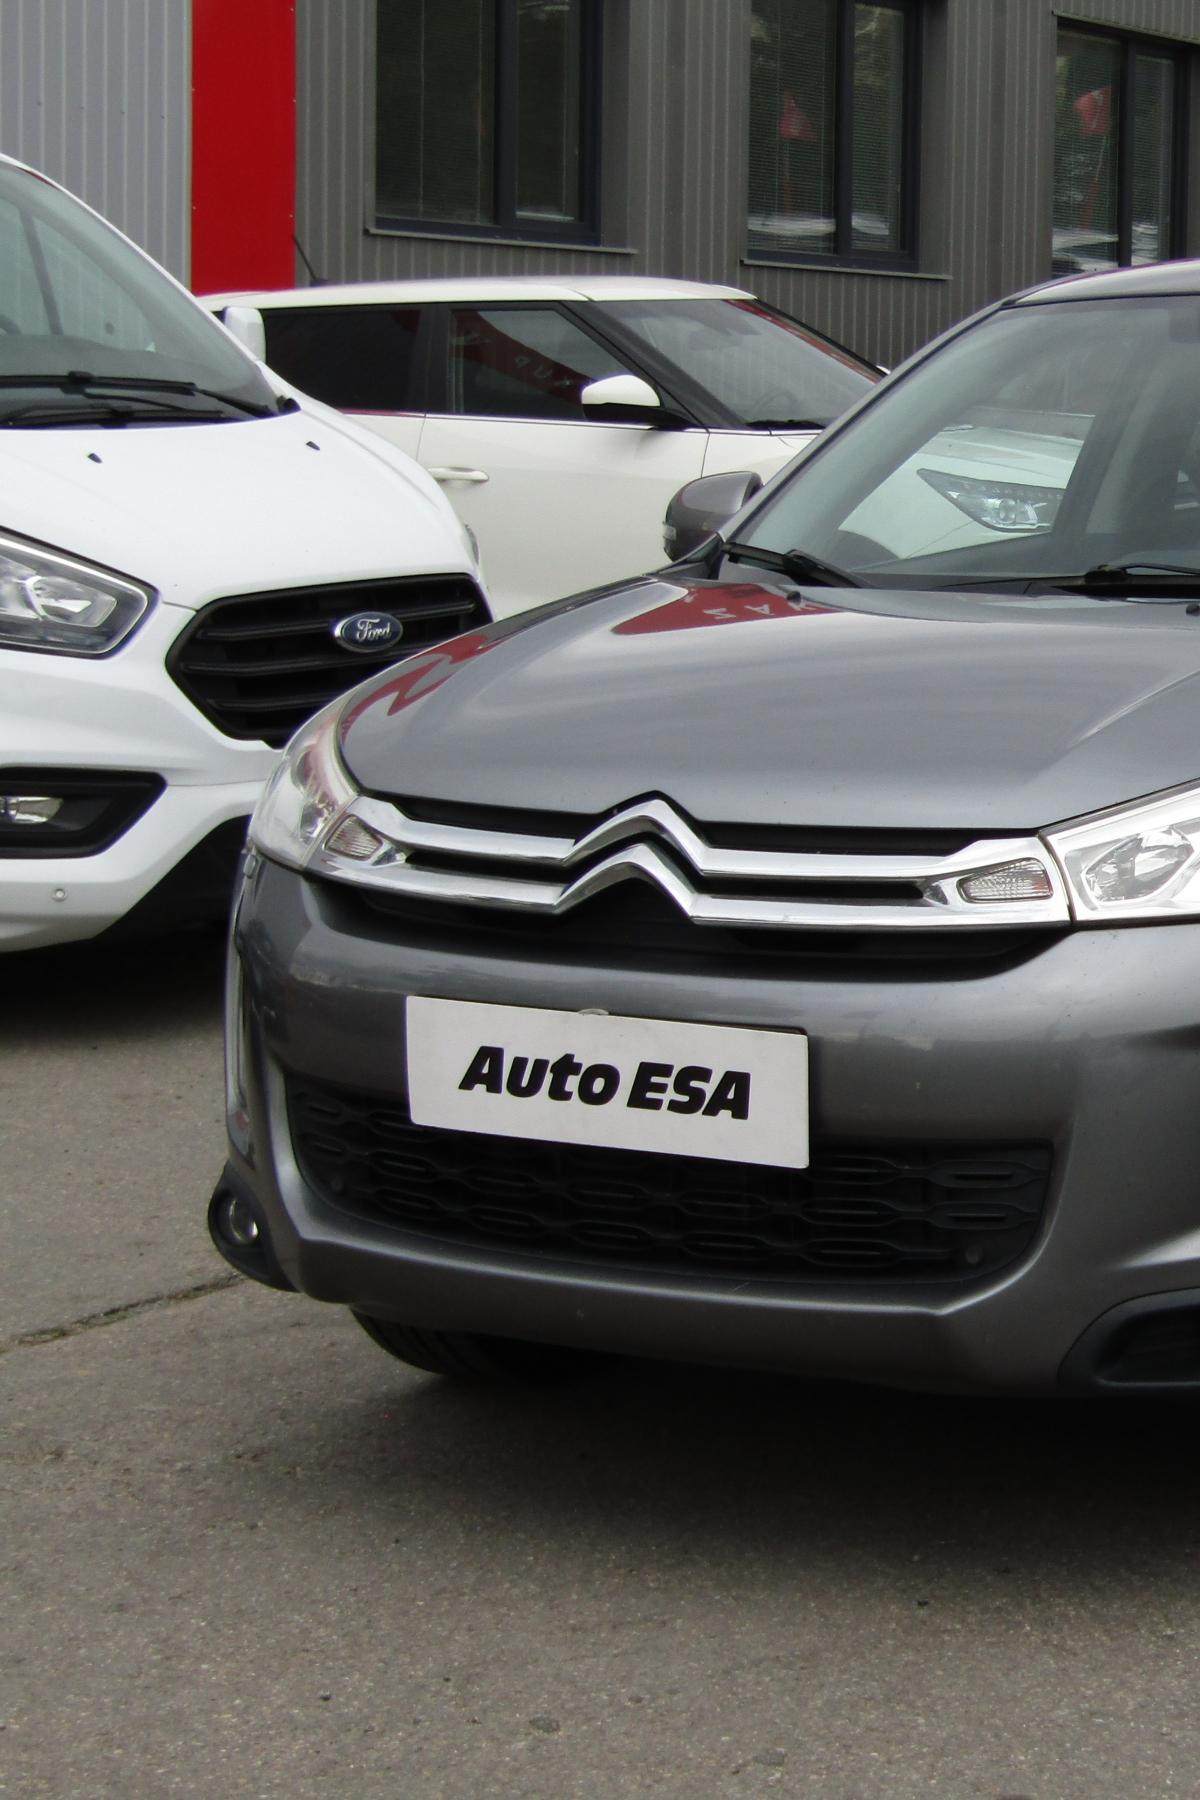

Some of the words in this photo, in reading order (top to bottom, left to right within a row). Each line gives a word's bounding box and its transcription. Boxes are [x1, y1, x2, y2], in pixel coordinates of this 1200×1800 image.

[356, 618, 392, 642] Ford
[459, 1045, 621, 1106] Auto
[626, 1061, 751, 1120] ESA
